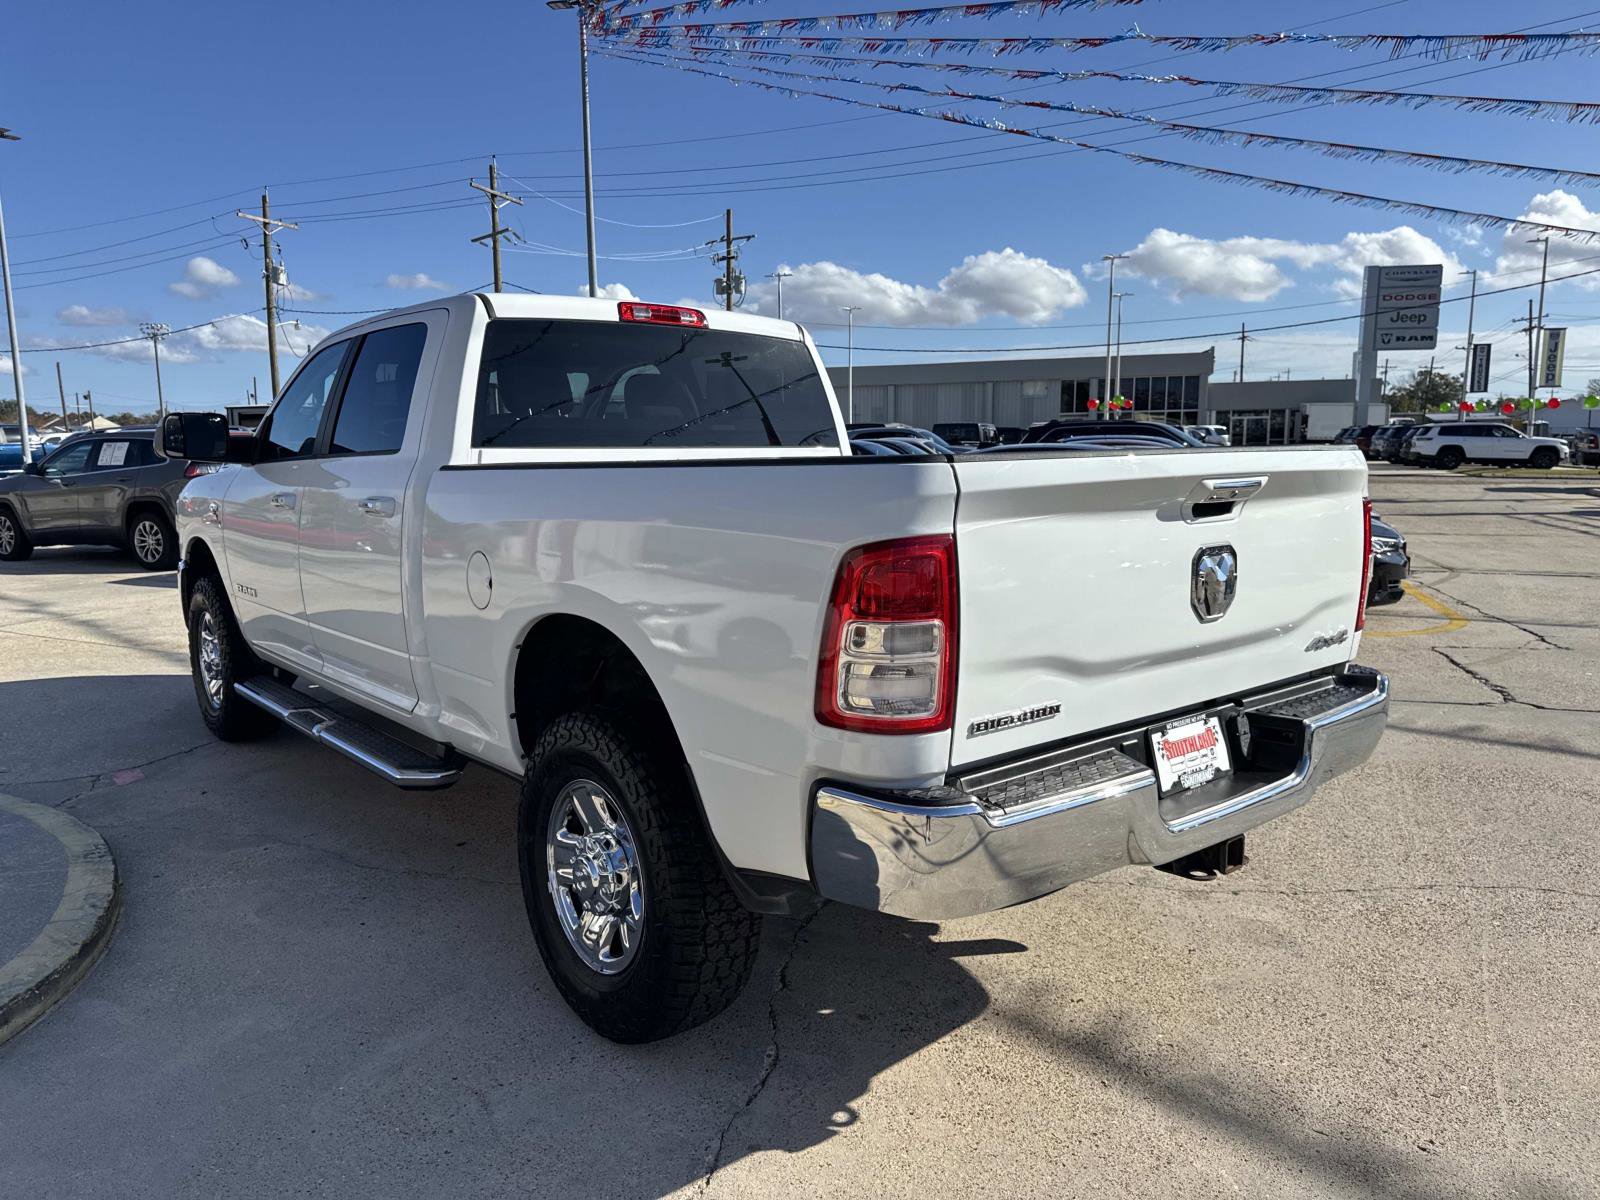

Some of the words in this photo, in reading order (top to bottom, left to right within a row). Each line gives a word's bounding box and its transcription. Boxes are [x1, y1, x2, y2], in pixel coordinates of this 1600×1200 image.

[1382, 293, 1438, 301] DODGE
[1390, 311, 1427, 325] Jeep
[1545, 341, 1559, 384] Jeep
[1163, 727, 1216, 760] SOUTHLAND
